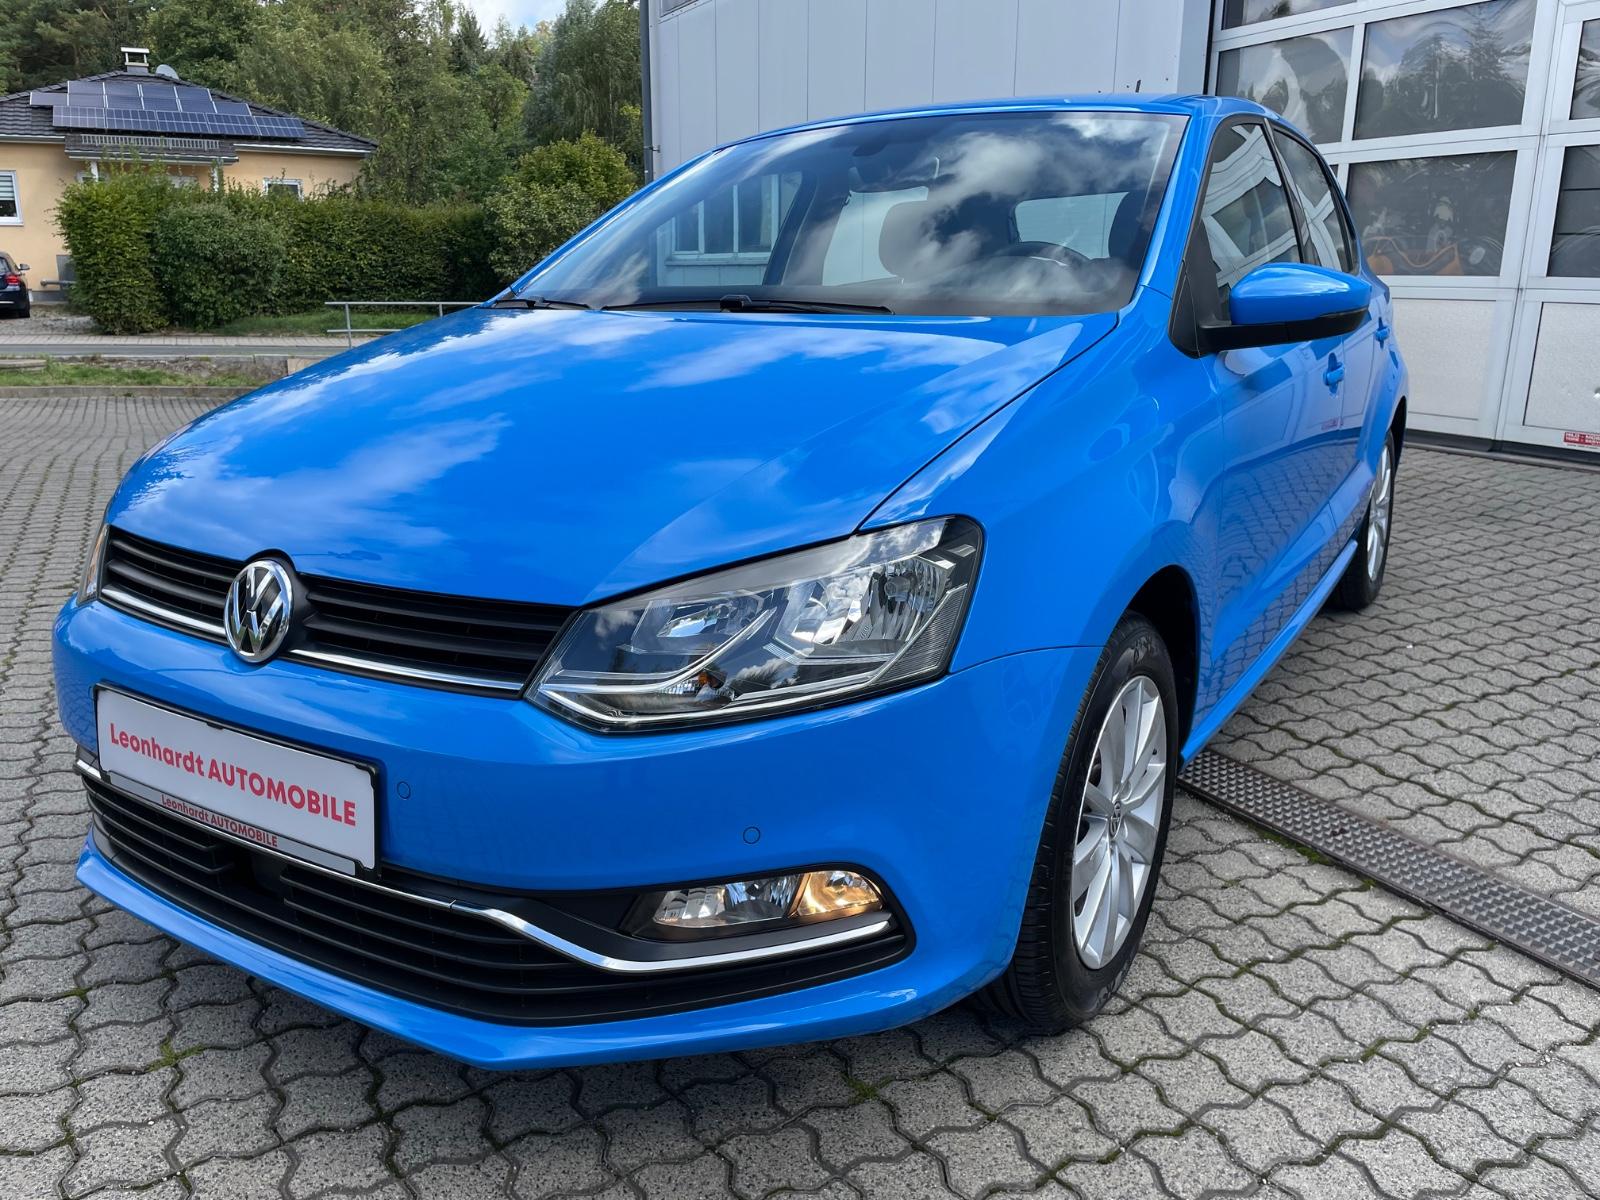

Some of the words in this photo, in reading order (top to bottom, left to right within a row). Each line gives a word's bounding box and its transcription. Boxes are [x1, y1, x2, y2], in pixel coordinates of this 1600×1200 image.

[224, 560, 292, 662] VW
[110, 723, 204, 777] Leonhardt
[208, 759, 356, 826] AUTOMOBILE
[161, 794, 208, 822] Leonhardt
[211, 815, 277, 847] AUTOMOBILE
